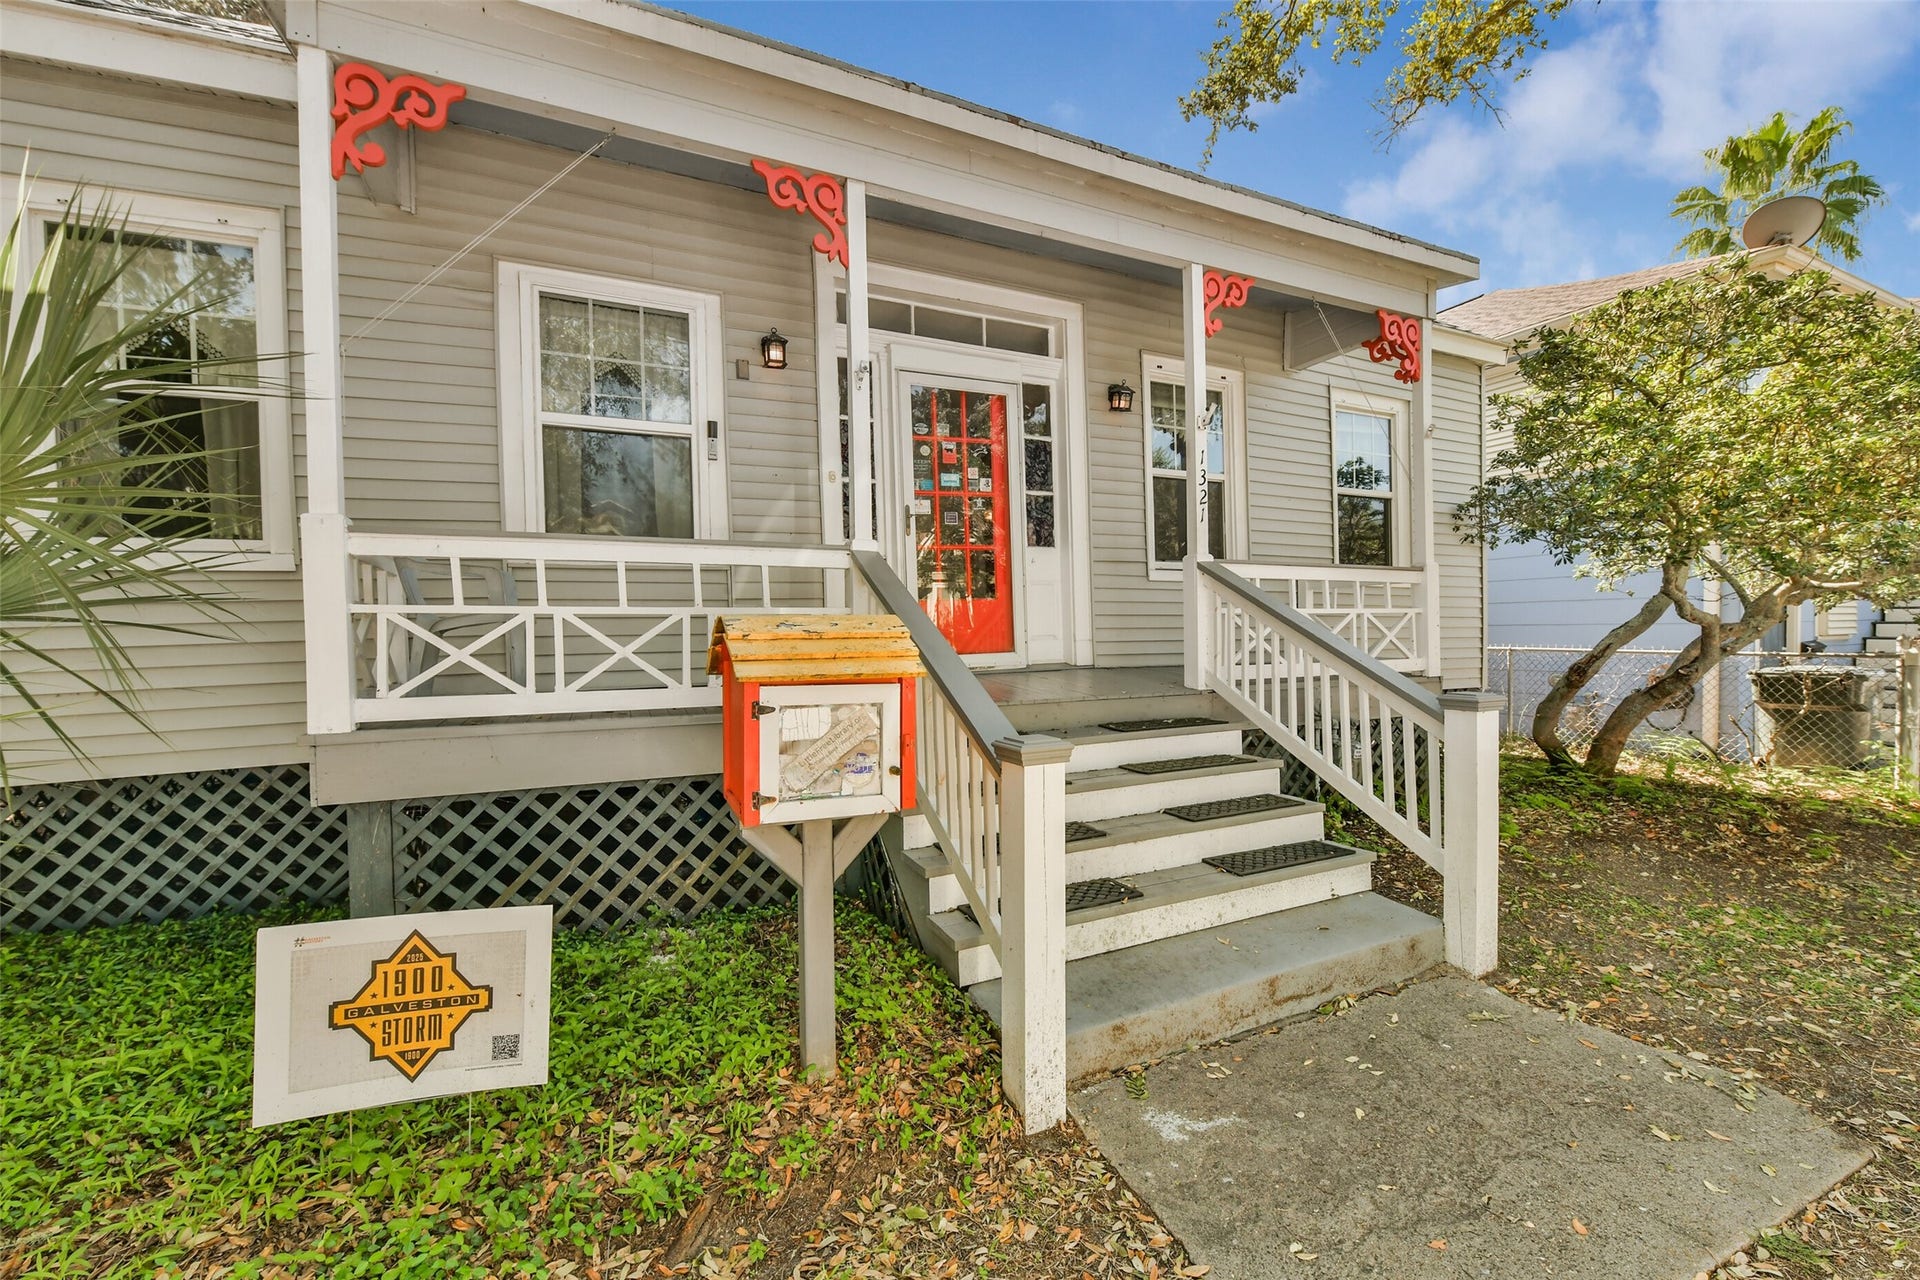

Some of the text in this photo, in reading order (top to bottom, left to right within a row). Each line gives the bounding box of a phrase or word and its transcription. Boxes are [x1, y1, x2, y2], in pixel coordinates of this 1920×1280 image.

[1199, 450, 1208, 522] 1321
[406, 953, 424, 962] 2025
[382, 965, 443, 998] 1900
[347, 995, 477, 1018] GALVESTON
[382, 1013, 443, 1047] STORM
